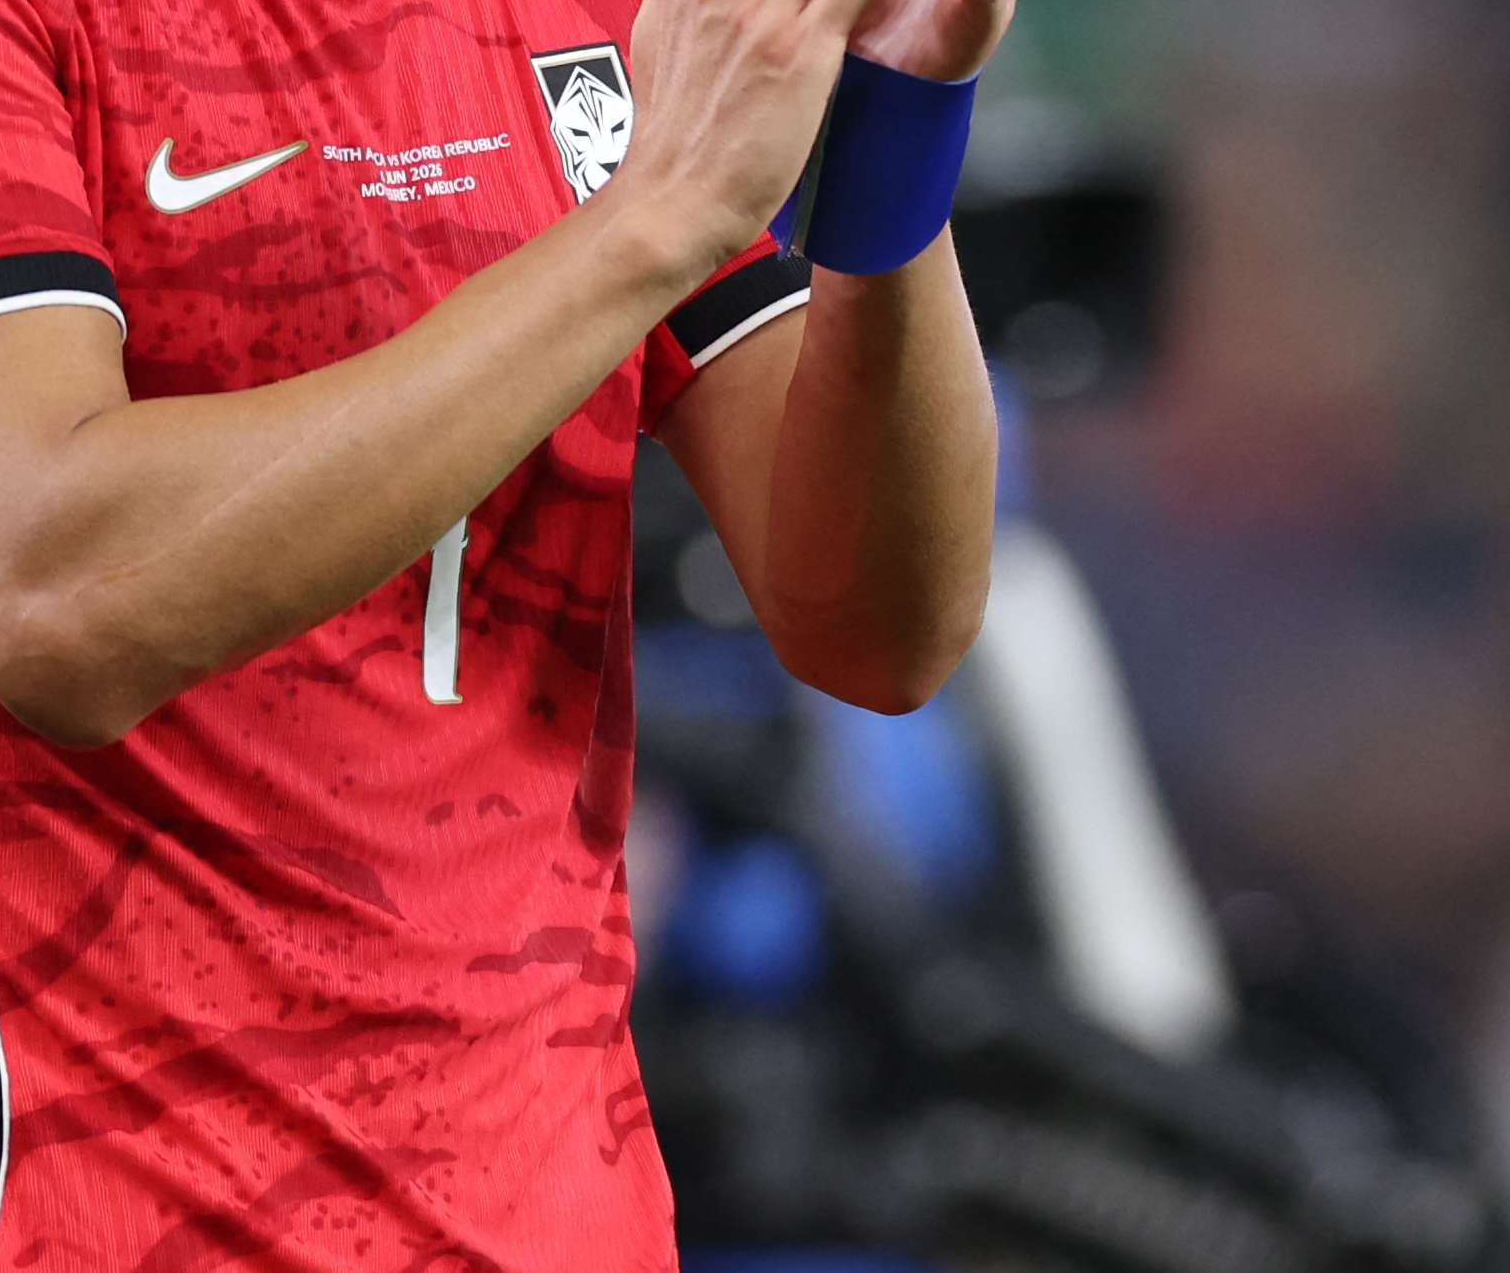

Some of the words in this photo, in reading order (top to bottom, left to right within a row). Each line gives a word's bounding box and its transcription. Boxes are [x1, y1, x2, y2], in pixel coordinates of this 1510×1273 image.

[400, 145, 443, 165] KOREA
[444, 133, 511, 157] REPUBLIC
[410, 163, 443, 181] 2026
[424, 176, 475, 196] MEXICO
